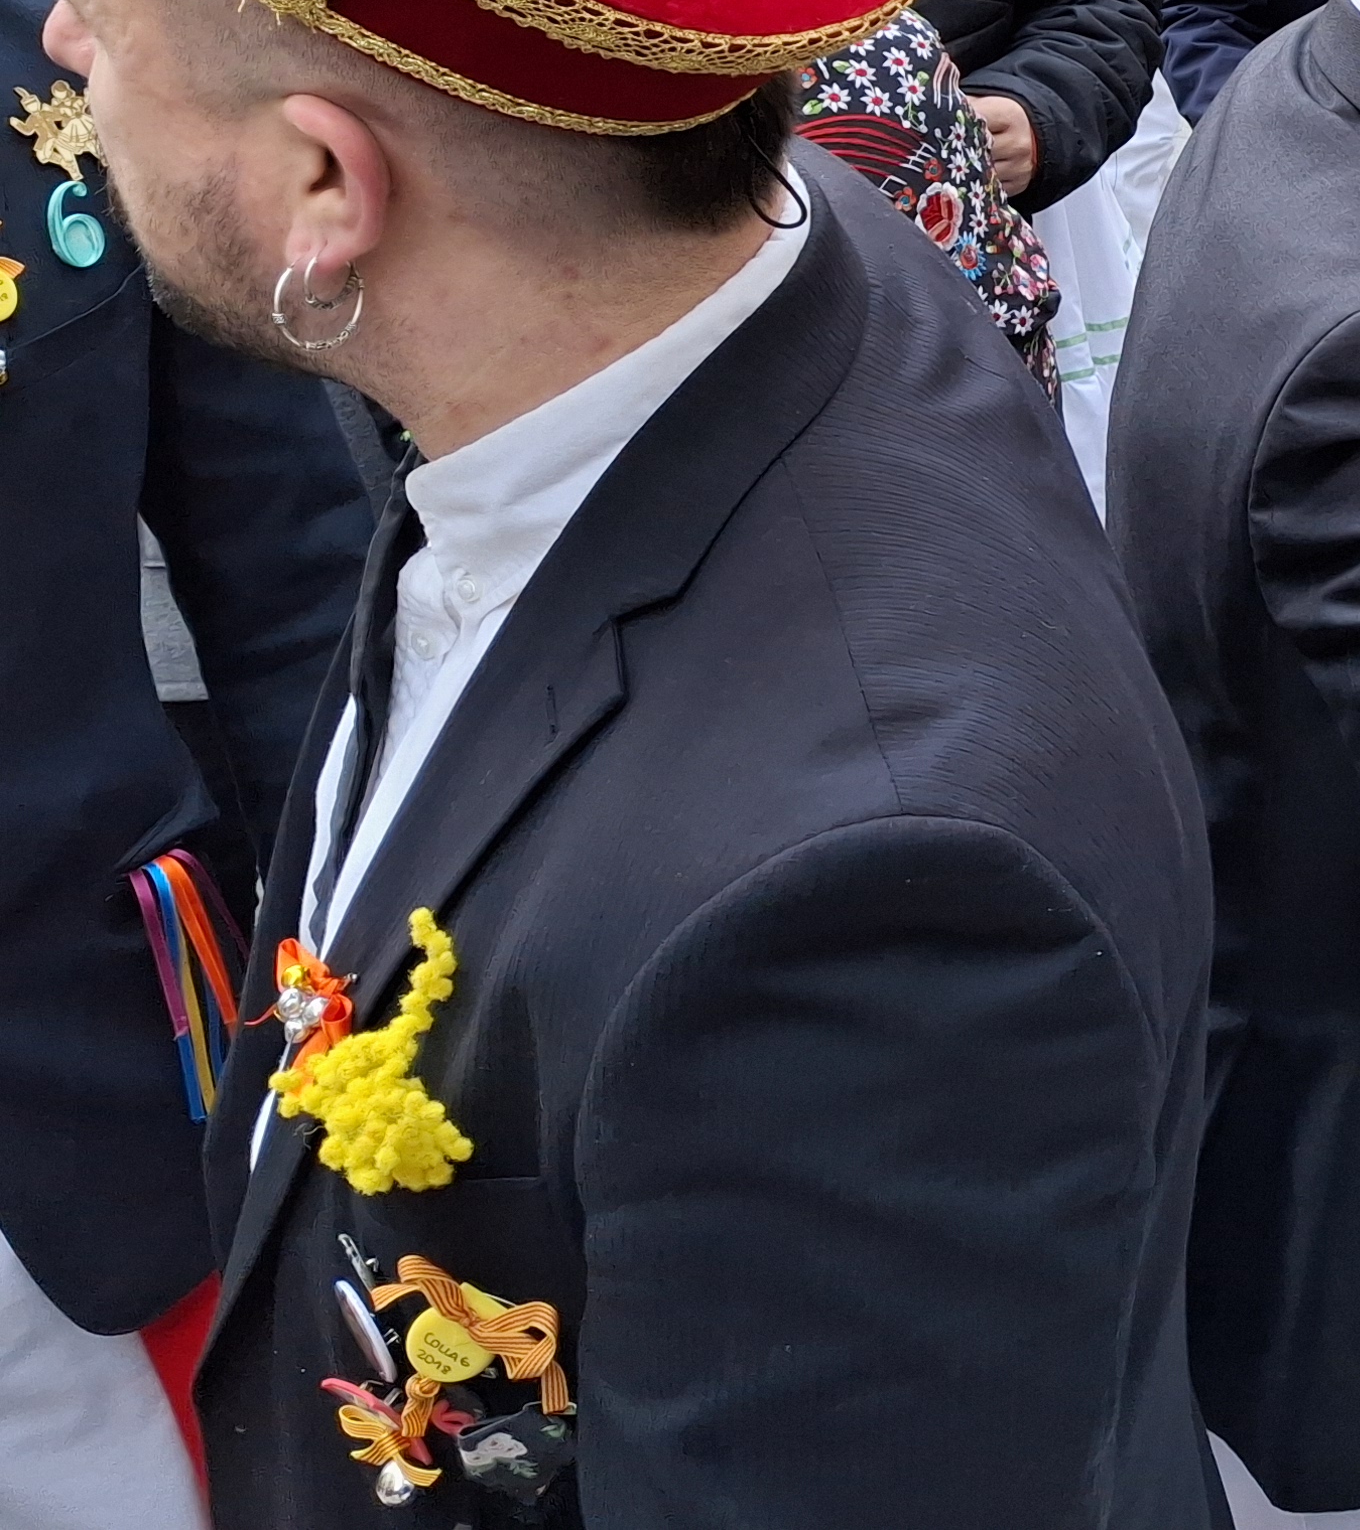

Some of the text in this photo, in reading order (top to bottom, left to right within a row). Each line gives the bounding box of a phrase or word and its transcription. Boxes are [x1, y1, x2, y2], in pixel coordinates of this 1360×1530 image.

[47, 180, 105, 268] 6
[417, 1348, 452, 1375] 2018
[460, 1356, 470, 1368] 6
